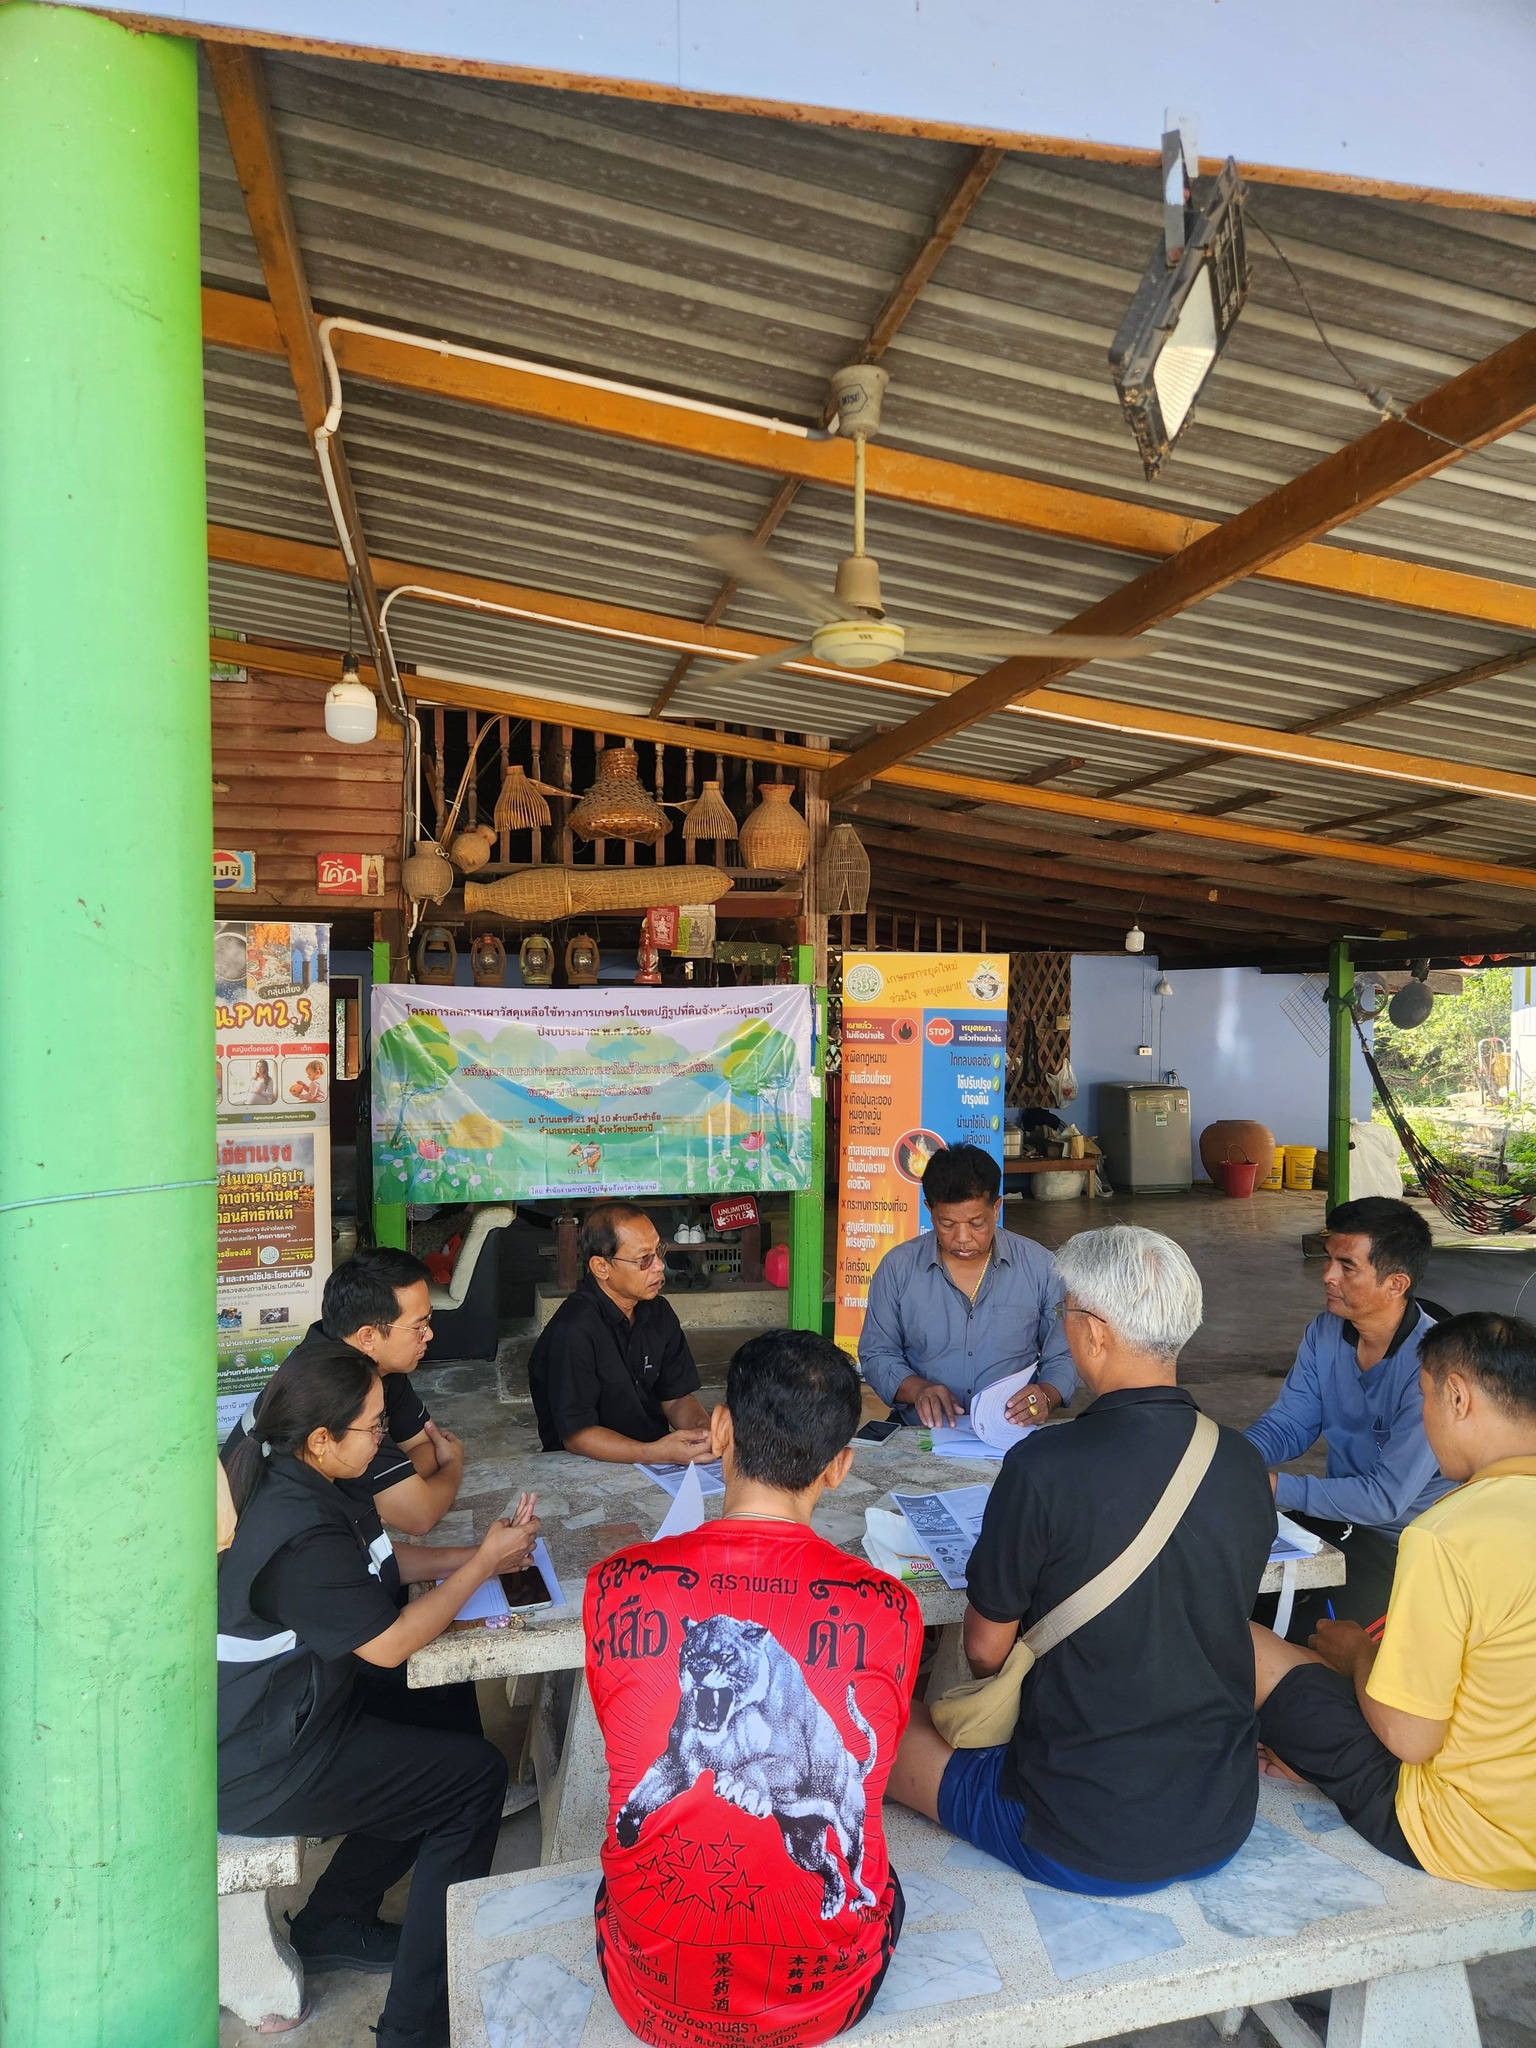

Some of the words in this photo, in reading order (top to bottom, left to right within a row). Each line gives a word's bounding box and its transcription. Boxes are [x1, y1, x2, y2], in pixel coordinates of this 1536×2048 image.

[320, 860, 357, 884] โค้ก
[886, 960, 959, 985] เกษตรกรยุคใหม่
[890, 989, 917, 1004] ร่วมใจ
[627, 1026, 652, 1036] 2569
[929, 1028, 951, 1036] STOP
[301, 1044, 312, 1052] เด็ก
[849, 1050, 888, 1067] ผิดกฎหมาย
[601, 1114, 611, 1123] 10
[848, 1107, 882, 1121] หมอกควัน
[717, 1202, 752, 1216] UNLIMITED
[725, 1212, 747, 1223] STYLE
[296, 1252, 314, 1261] 1764
[845, 1257, 871, 1272] โลกร้อน
[255, 1337, 280, 1346] Linkage
[709, 1572, 799, 1596] สุราผสม
[607, 1594, 672, 1661] เสือ
[803, 1605, 868, 1673] ดำ
[785, 1954, 809, 1995] 本药酒
[710, 1951, 735, 2014] 黑虎药酒
[681, 2029, 690, 2039] 3
